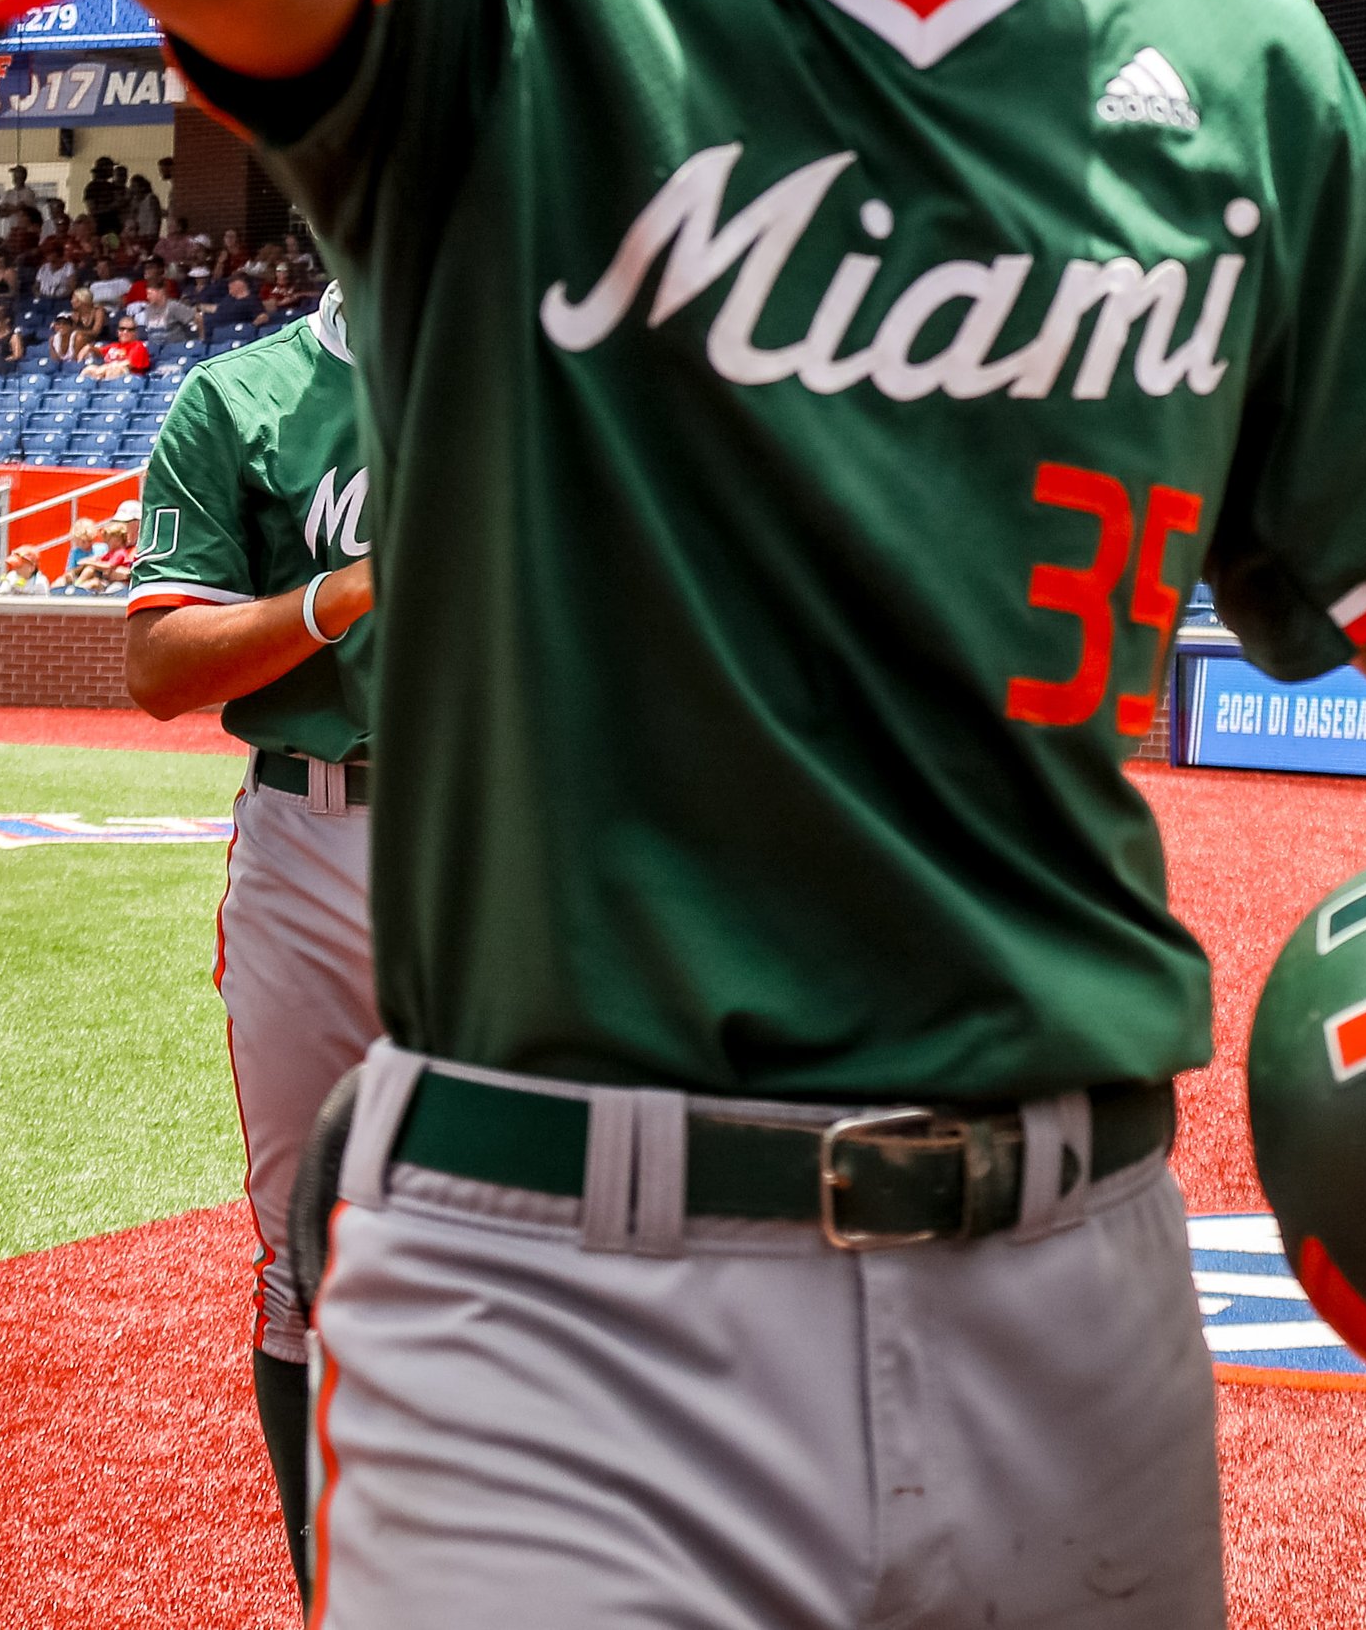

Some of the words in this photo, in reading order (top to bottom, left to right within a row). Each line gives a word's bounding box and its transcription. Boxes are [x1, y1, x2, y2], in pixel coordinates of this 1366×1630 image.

[539, 141, 1262, 402] Miami
[1006, 461, 1203, 737] 35
[1216, 694, 1264, 734] 2021
[1268, 696, 1289, 736] DI
